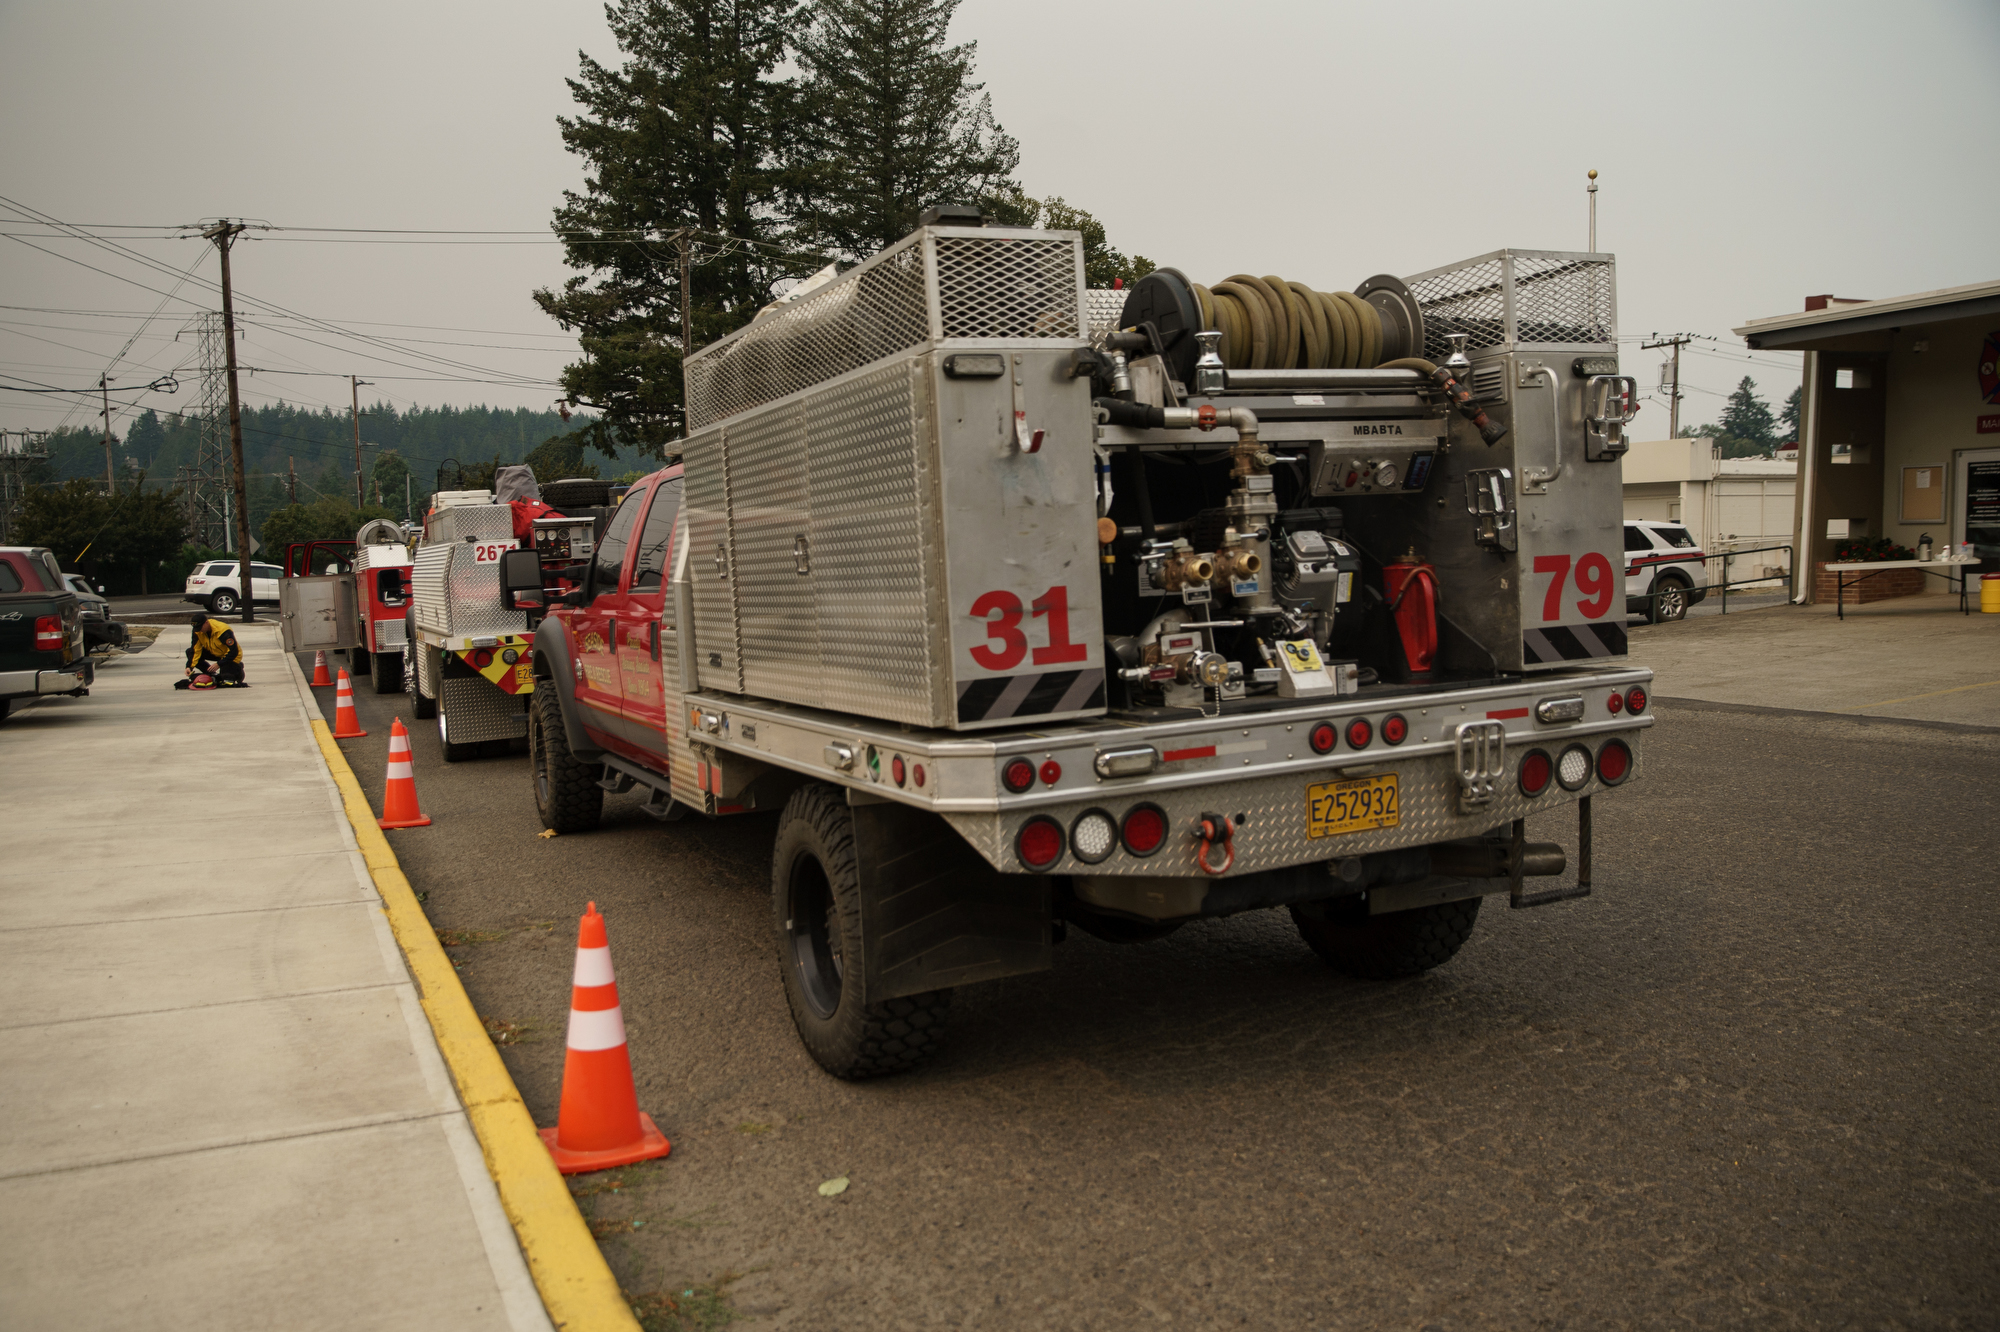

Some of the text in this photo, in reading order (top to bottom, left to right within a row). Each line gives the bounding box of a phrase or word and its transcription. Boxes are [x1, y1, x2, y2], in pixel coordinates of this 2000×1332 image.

[1353, 425, 1402, 435] MBABTA
[1533, 552, 1614, 621] 79
[969, 586, 1087, 671] 31
[1336, 780, 1371, 791] OREGON
[1311, 786, 1396, 823] E252932
